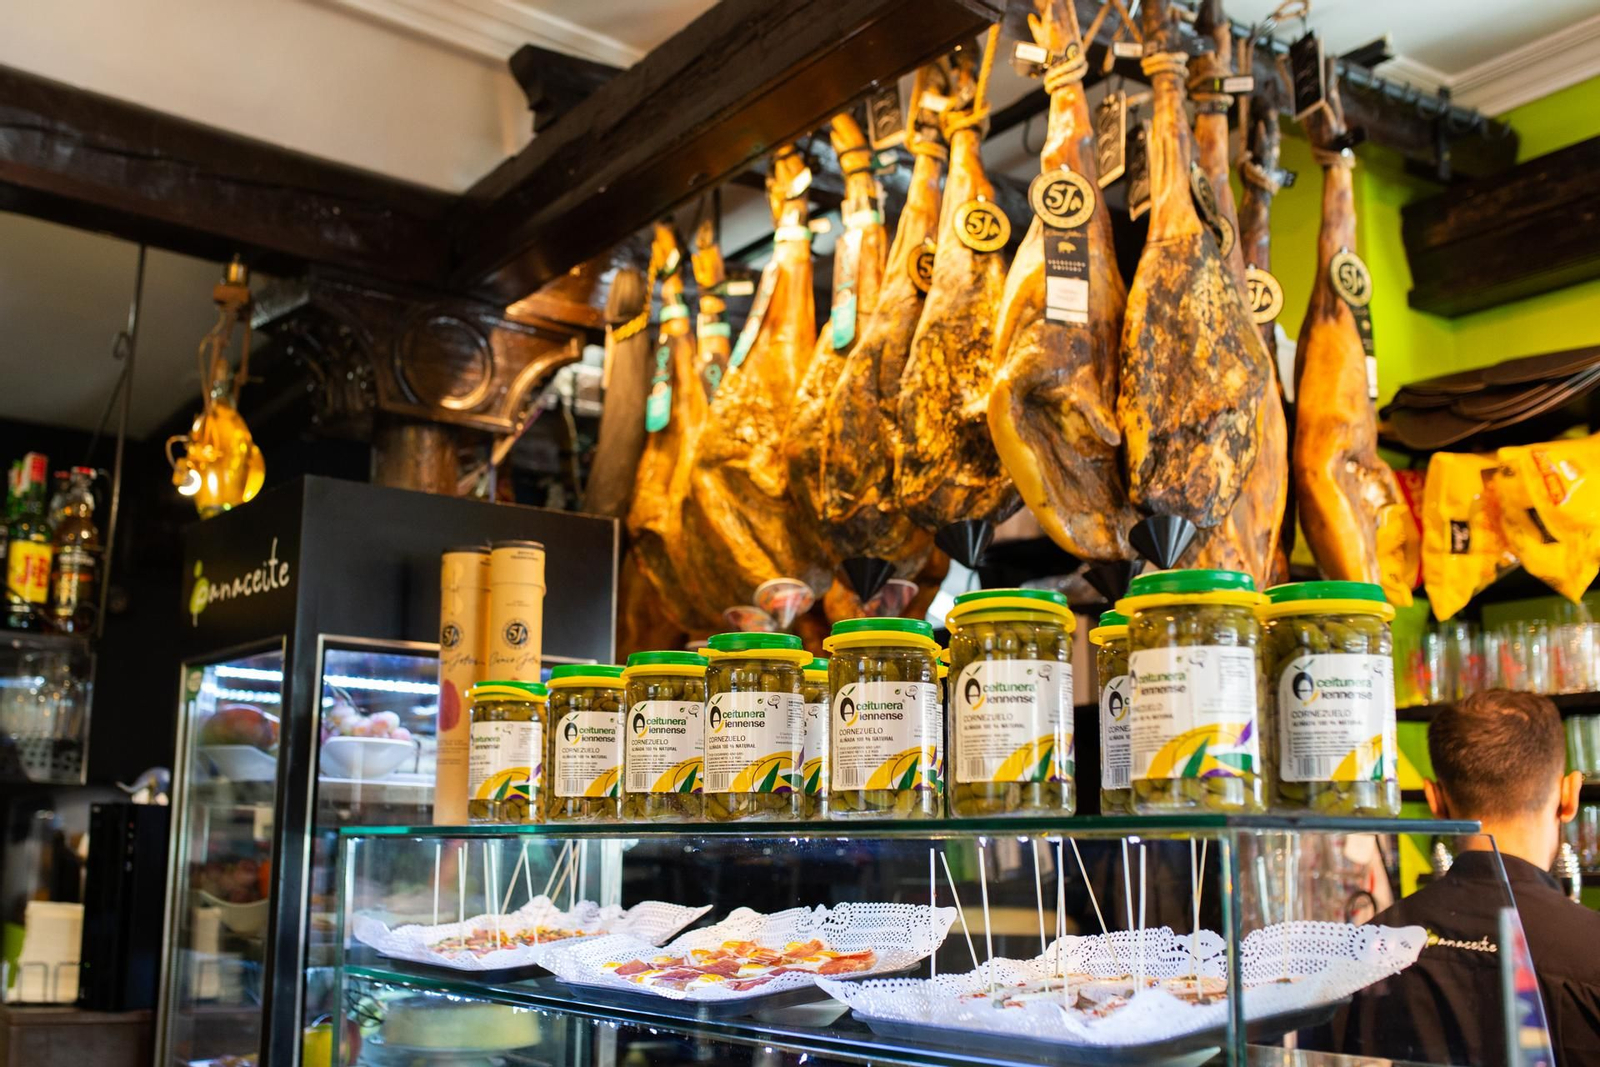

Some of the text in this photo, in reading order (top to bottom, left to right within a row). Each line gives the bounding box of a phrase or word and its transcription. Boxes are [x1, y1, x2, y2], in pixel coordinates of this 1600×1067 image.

[963, 713, 1014, 722] CORNEZUELO
[1292, 709, 1352, 719] CORNEZUELO
[839, 727, 884, 736] CORNEZUELO
[708, 735, 747, 743] CORNEZUELO
